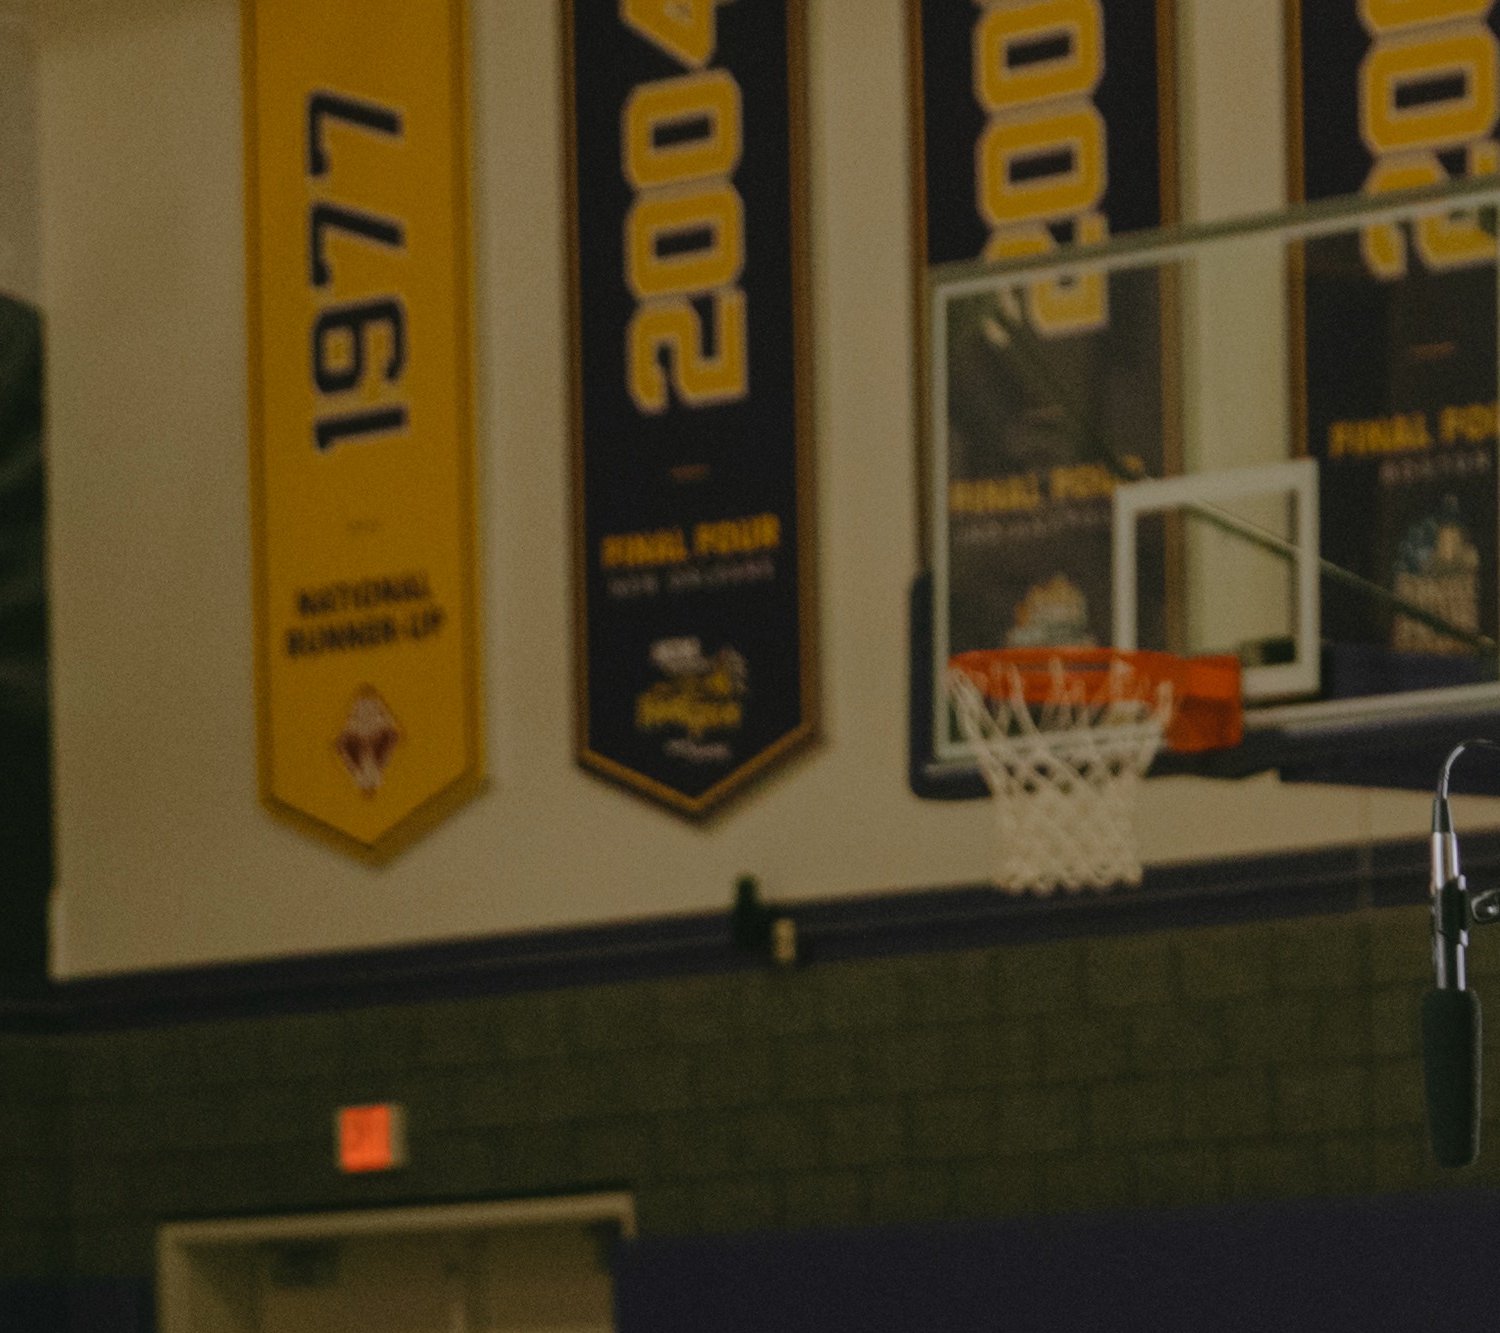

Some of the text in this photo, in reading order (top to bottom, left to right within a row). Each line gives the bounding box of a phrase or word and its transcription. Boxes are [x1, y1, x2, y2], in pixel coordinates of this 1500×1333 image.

[972, 0, 1109, 346] 200
[307, 88, 412, 455] 1977
[1328, 402, 1498, 459] FINAL FOU
[601, 513, 781, 568] FINAL FOUR
[296, 571, 433, 617] NATIONAL
[286, 605, 445, 661] RUNNER-UP
